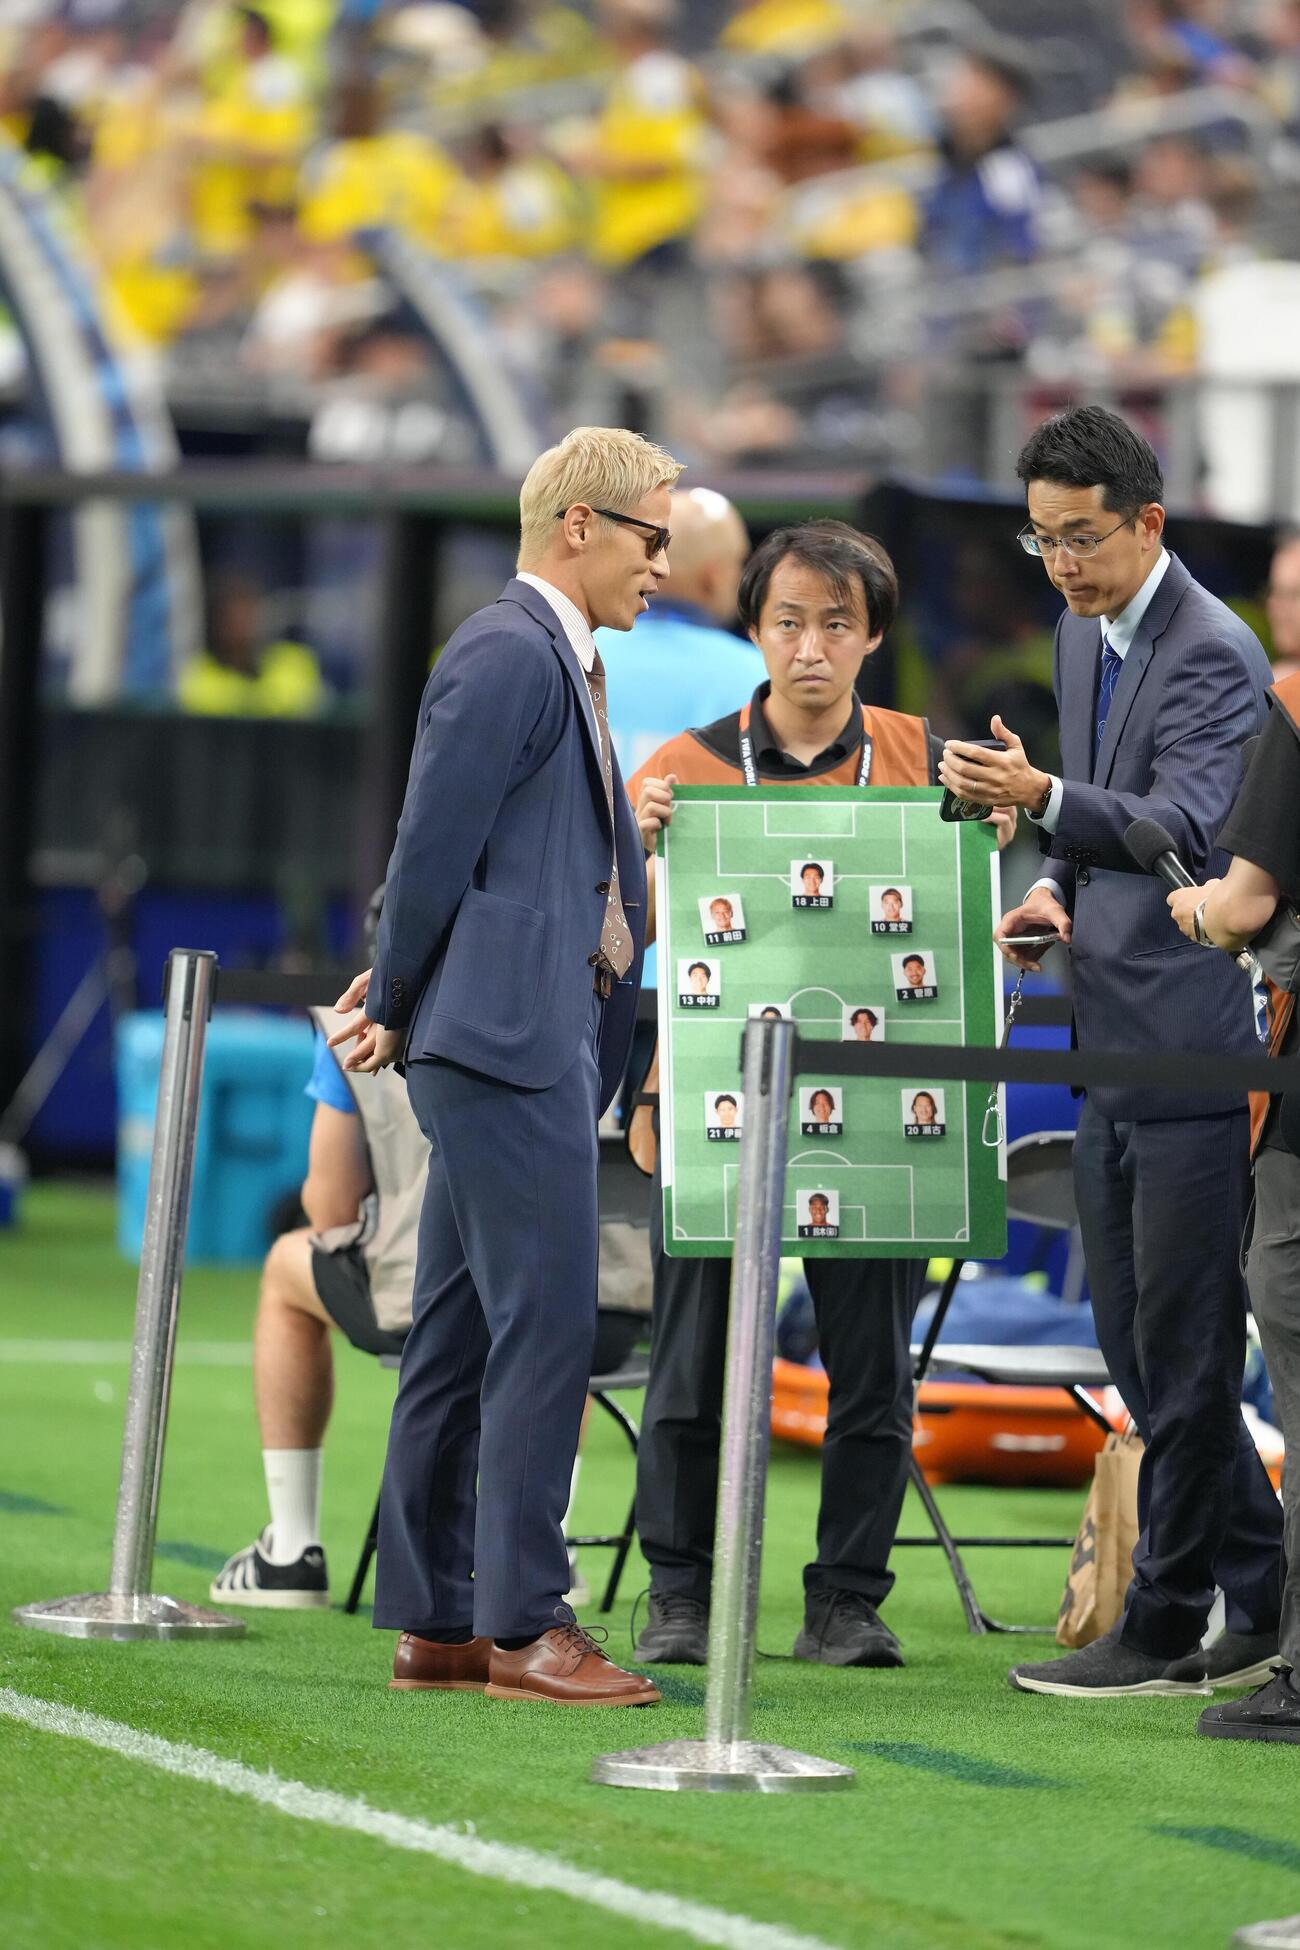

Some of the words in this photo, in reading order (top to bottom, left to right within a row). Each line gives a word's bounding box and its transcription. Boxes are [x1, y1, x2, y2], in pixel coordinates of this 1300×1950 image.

[744, 757, 756, 787] WORL
[795, 897, 807, 906] 18
[810, 897, 829, 907] 上田
[874, 923, 886, 932] 10
[708, 933, 719, 943] 11
[722, 931, 743, 942] 前田
[901, 990, 909, 999] 2
[681, 995, 694, 1005] 13
[696, 995, 716, 1006] 中村
[806, 1124, 813, 1133] 4
[907, 1126, 919, 1135] 20
[709, 1129, 720, 1138] 21
[803, 1227, 808, 1236] 1
